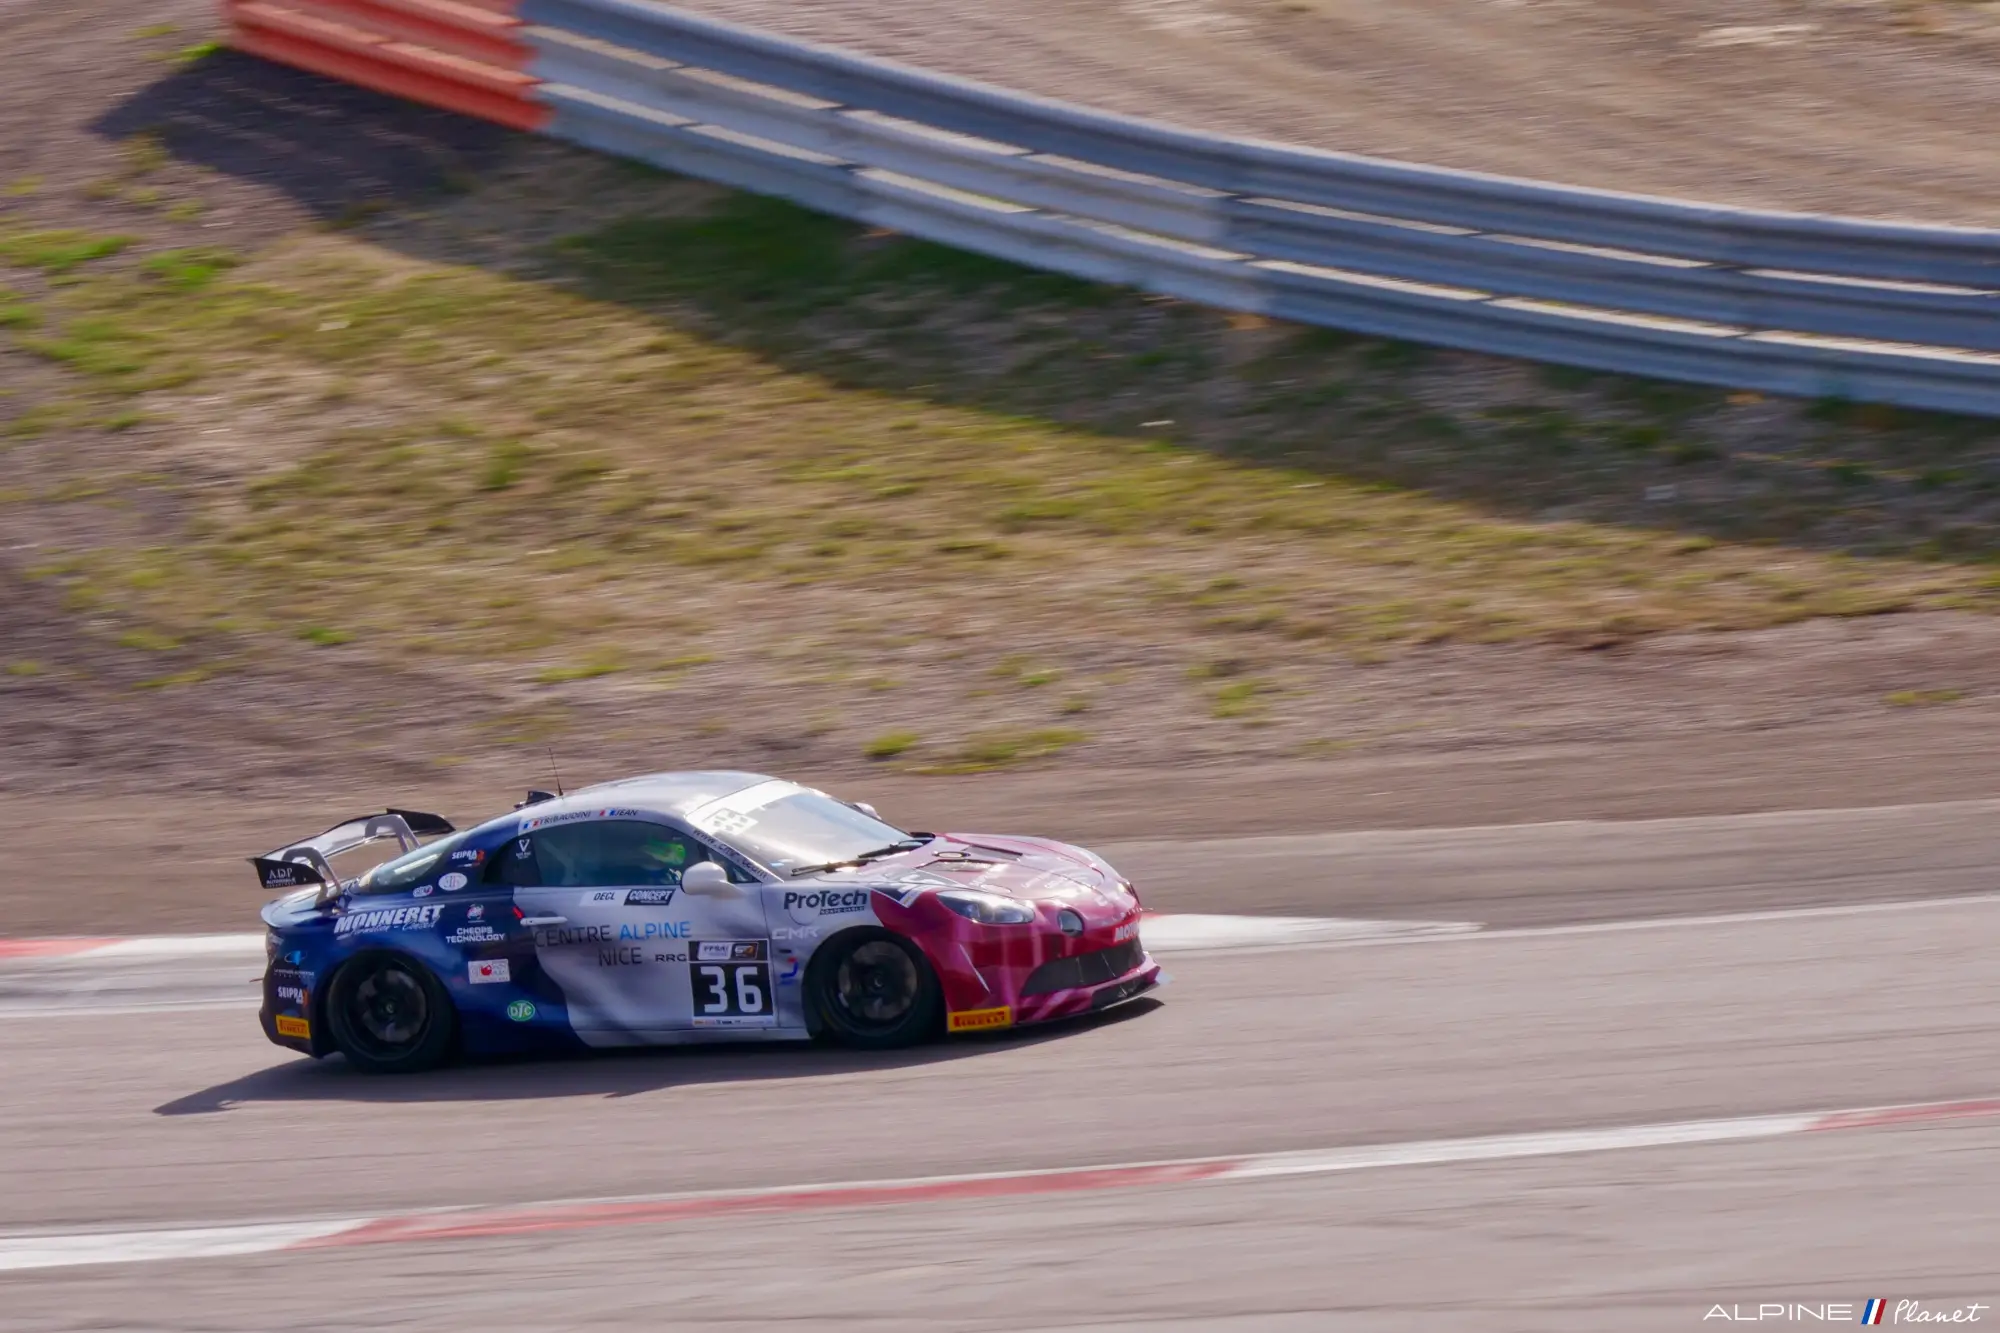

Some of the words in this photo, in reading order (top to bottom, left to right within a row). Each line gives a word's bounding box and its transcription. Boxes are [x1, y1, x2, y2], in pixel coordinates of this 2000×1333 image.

[615, 808, 638, 816] JEAN
[629, 889, 673, 901] CONCEPT
[783, 890, 868, 910] ProTech
[333, 904, 445, 934] MONNERET
[445, 933, 506, 943] TECHNOLOGY
[456, 926, 493, 935] CHEOPS
[534, 924, 613, 948] CENTRE
[619, 920, 693, 941] ALPINE
[599, 947, 643, 966] NICE
[655, 953, 688, 963] RRG
[700, 966, 763, 1013] 36
